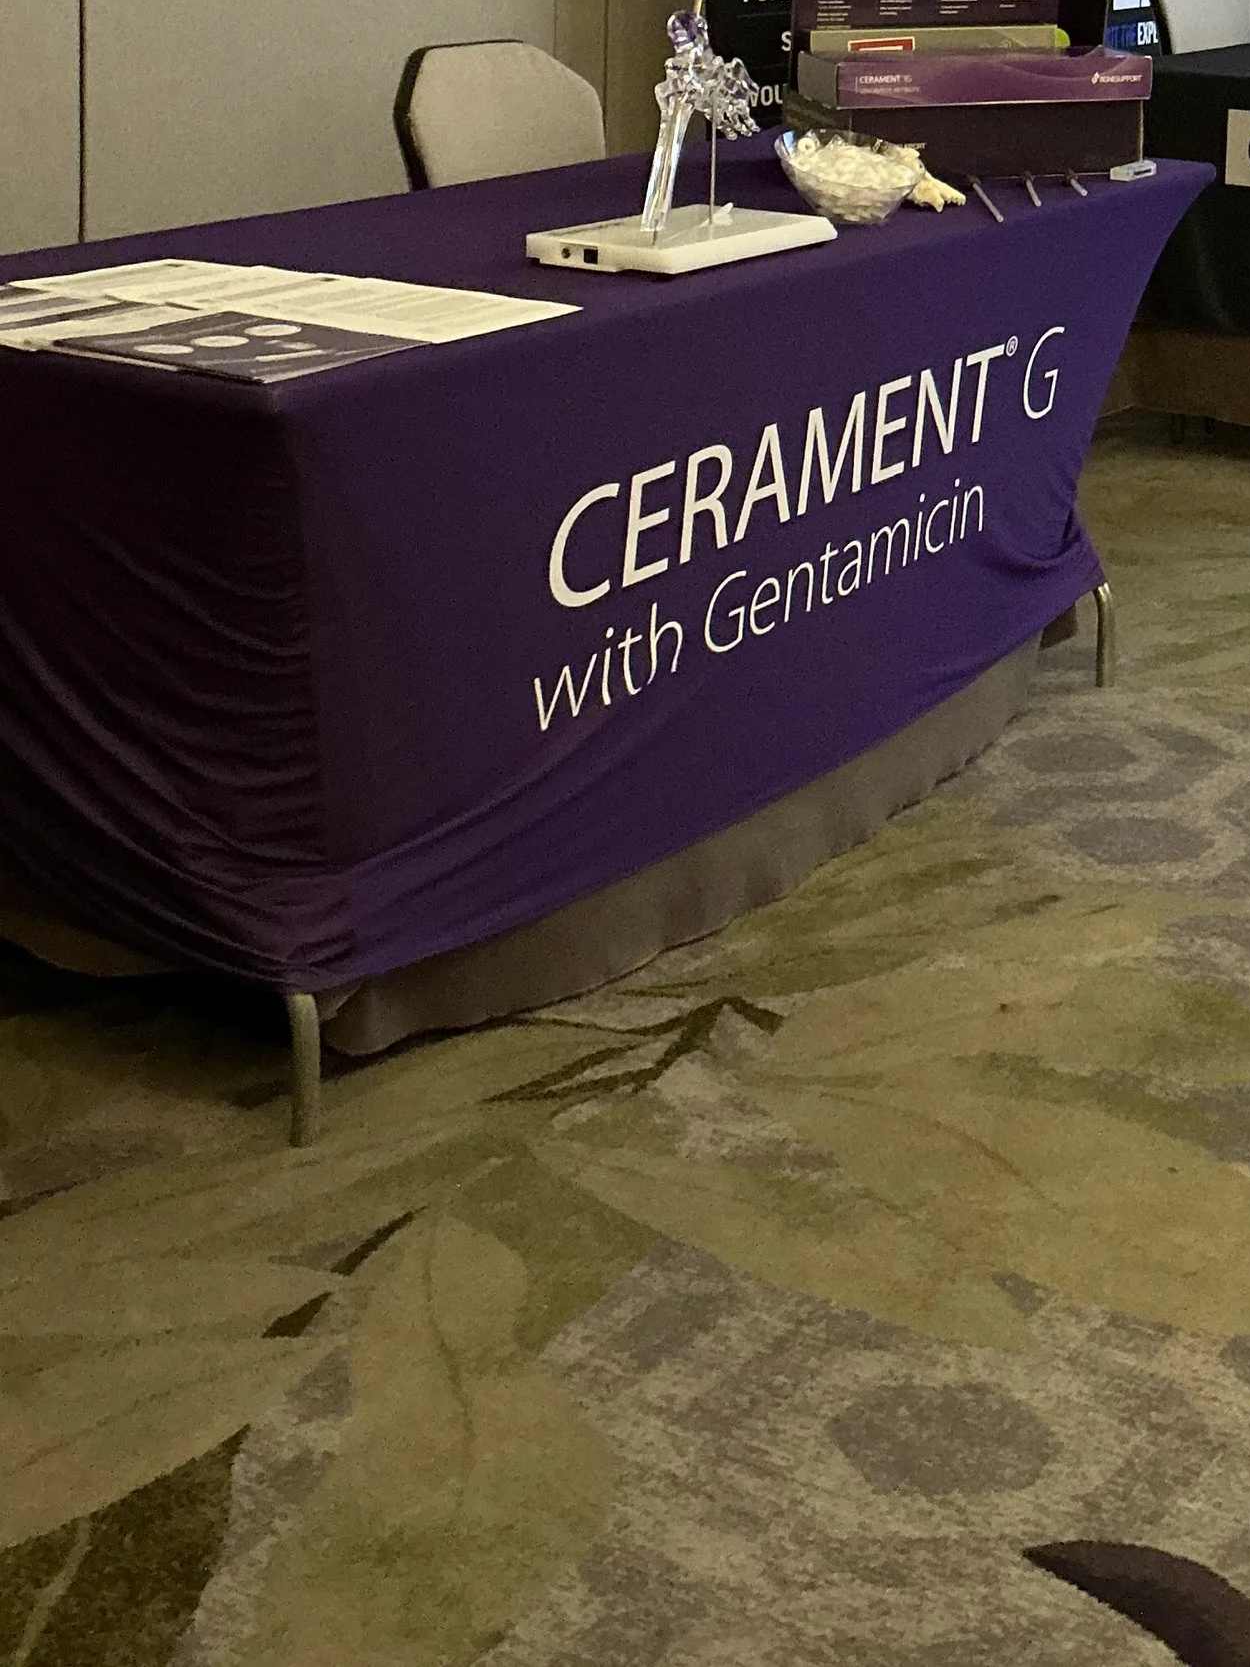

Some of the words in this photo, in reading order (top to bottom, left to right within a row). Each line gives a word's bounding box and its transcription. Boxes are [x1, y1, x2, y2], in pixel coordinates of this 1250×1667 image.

[860, 75, 900, 84] CERAMENT
[1023, 326, 1065, 420] G
[533, 602, 684, 732] with
[704, 478, 984, 654] Gentamicin
